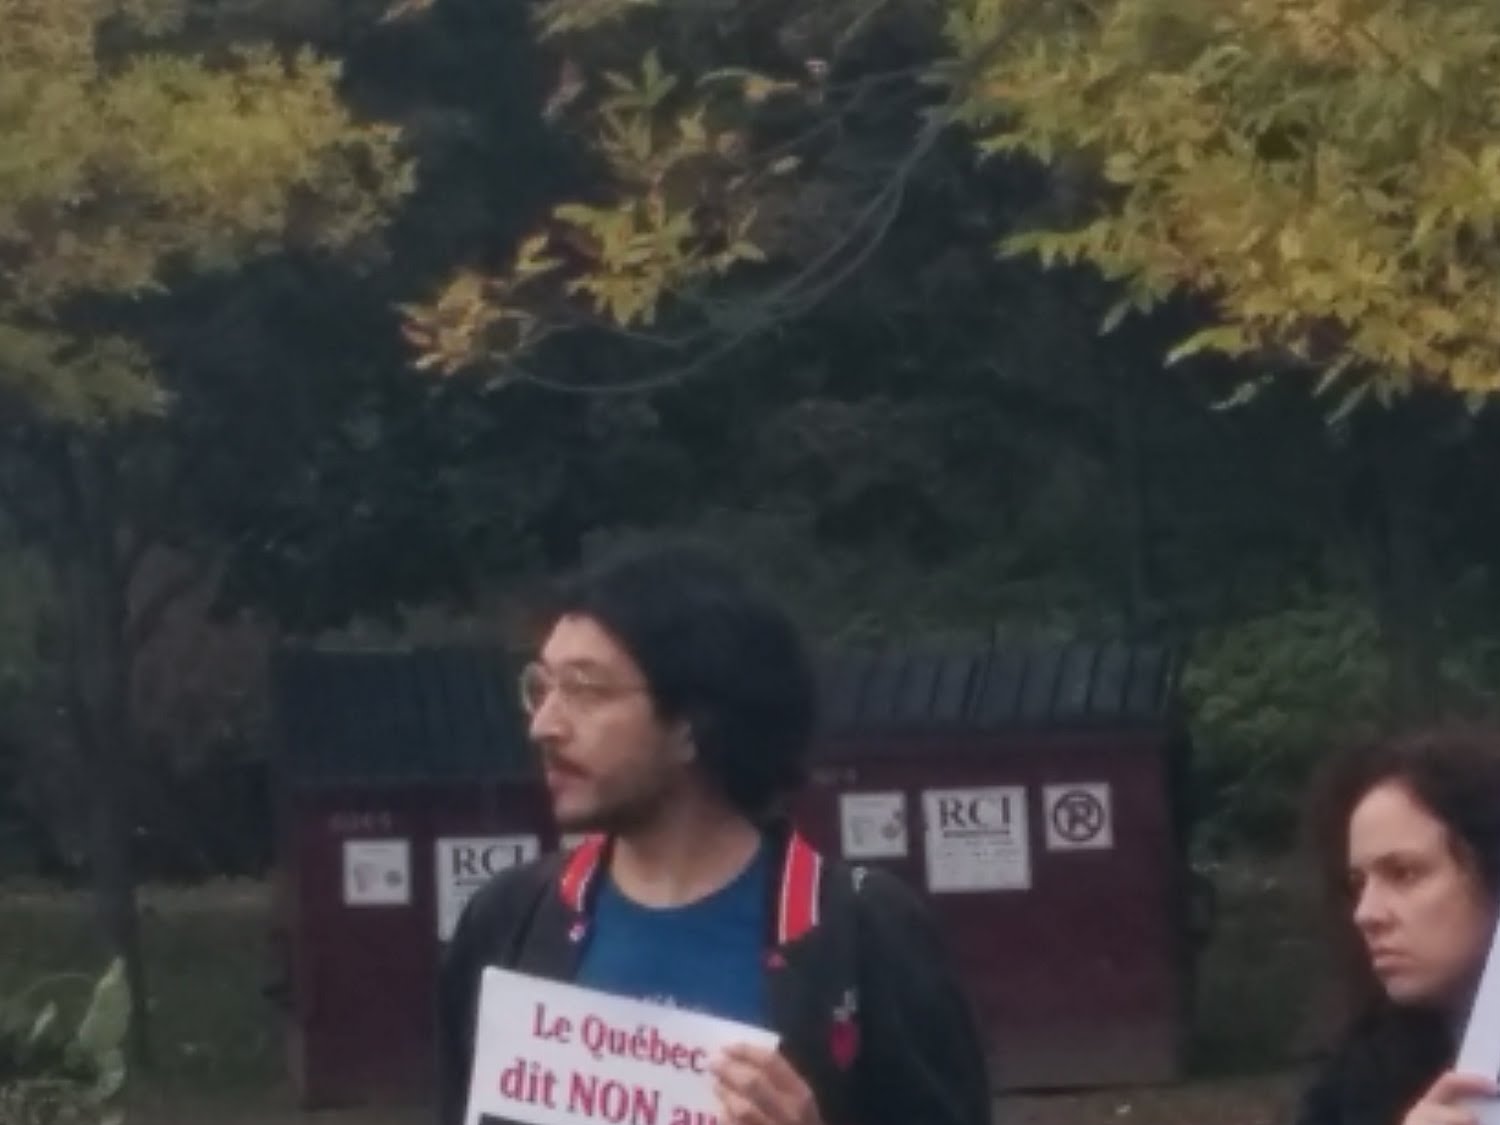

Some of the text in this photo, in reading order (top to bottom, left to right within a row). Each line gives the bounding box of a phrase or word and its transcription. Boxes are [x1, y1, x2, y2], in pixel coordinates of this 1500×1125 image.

[937, 795, 1012, 829] RCI
[532, 1002, 707, 1073] Le Québec
[499, 1057, 557, 1111] dit
